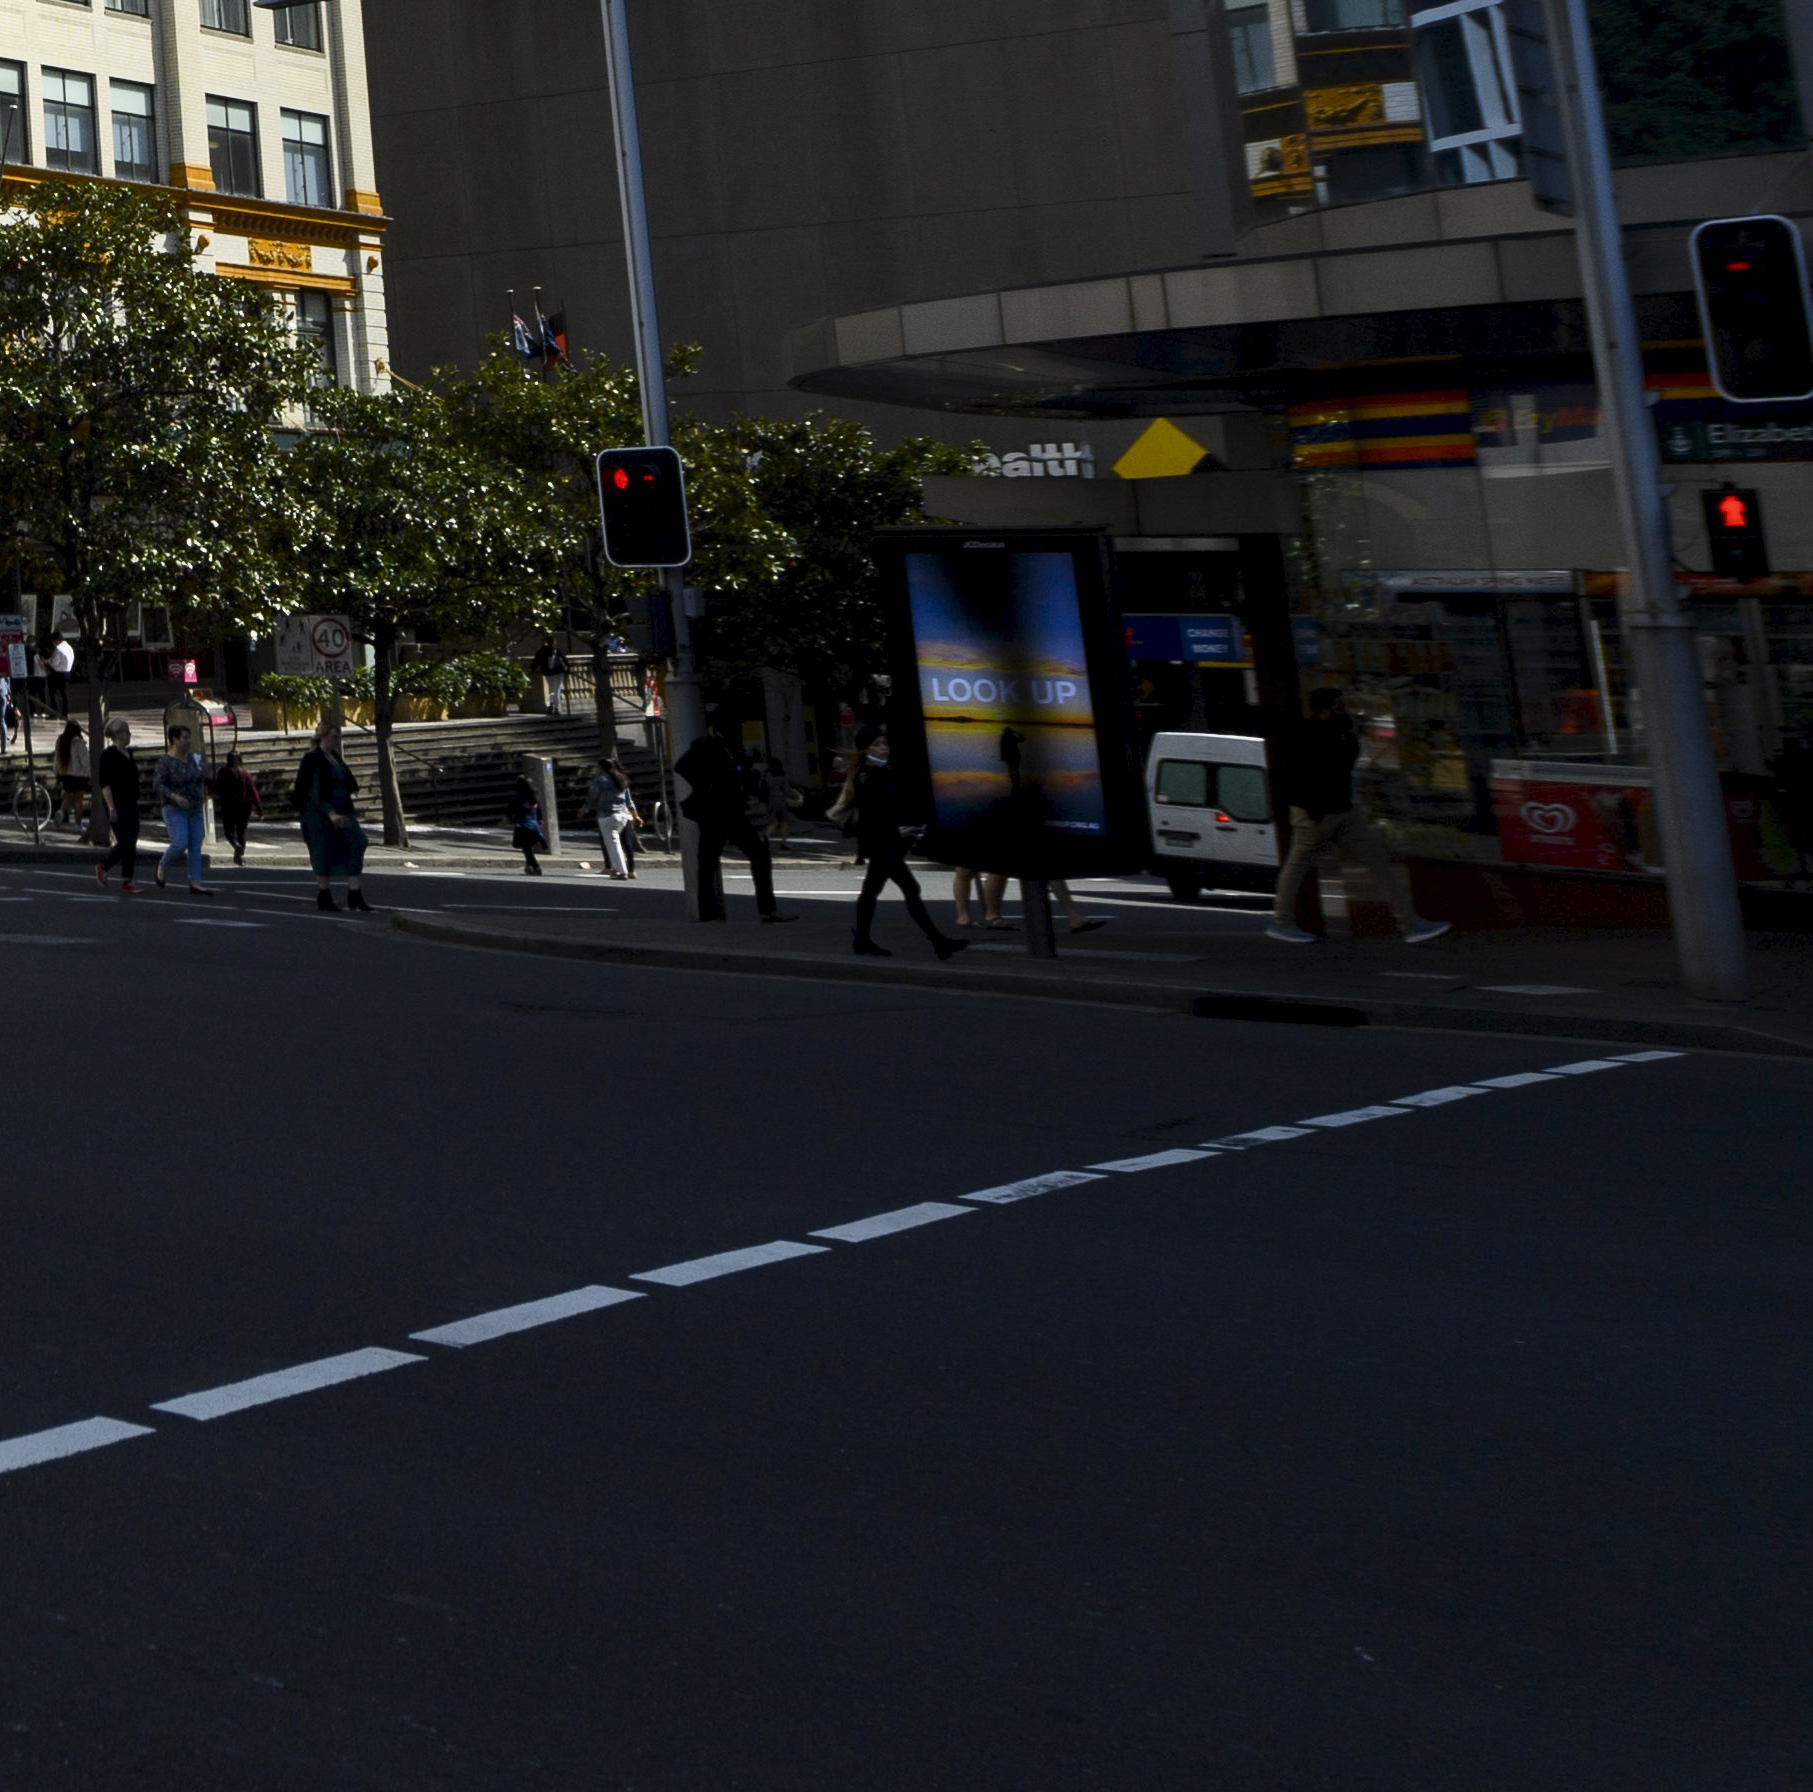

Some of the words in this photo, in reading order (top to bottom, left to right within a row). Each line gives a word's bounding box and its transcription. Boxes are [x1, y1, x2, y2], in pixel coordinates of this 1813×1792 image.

[317, 629, 346, 648] 40
[316, 660, 352, 673] AREA
[931, 677, 1020, 704] LOOK
[1030, 679, 1078, 705] UP
